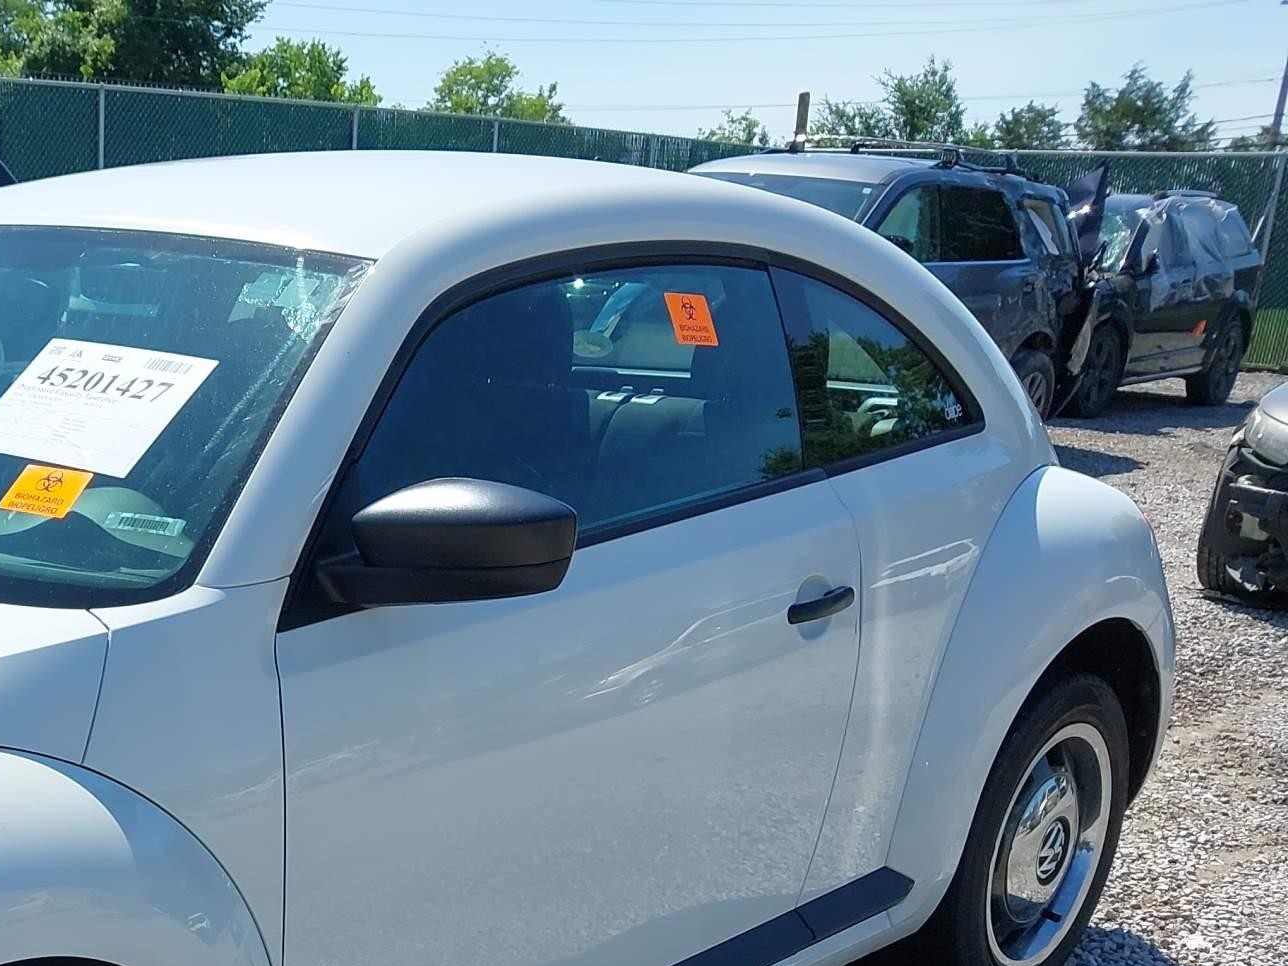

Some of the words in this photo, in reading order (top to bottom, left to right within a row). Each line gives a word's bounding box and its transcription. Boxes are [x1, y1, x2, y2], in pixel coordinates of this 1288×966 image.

[36, 365, 175, 403] 45201427
[14, 492, 64, 506] BIOHAZARD
[8, 500, 58, 515] BIOPELIGRO
